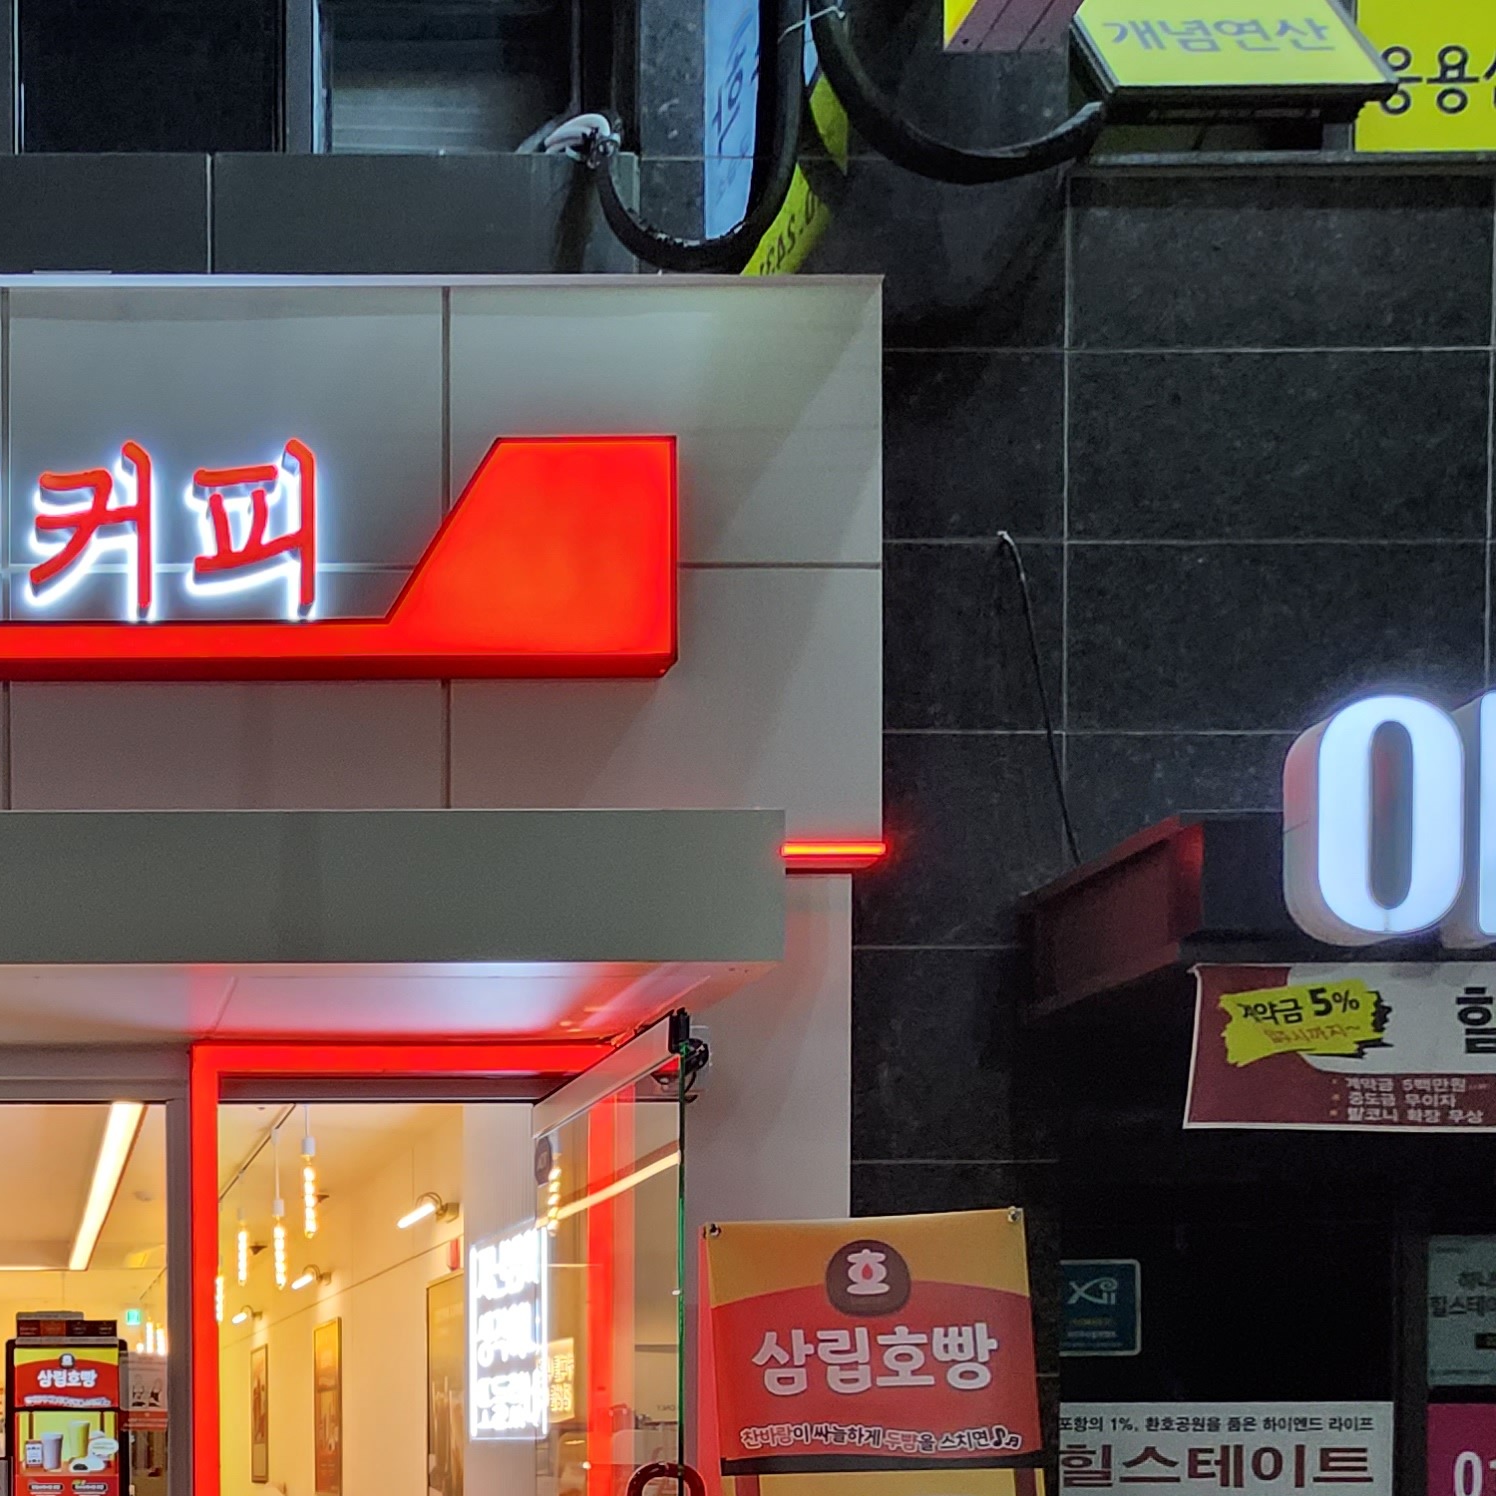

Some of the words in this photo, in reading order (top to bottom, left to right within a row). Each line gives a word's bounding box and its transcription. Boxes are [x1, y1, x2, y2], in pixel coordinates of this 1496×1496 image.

[1102, 16, 1335, 53] 개념연산
[1236, 999, 1303, 1026] 계약금
[1308, 987, 1360, 1017] 5%
[1404, 1092, 1457, 1108] 무이자
[1347, 1107, 1398, 1122] 발코니
[1406, 1108, 1441, 1123] 확장
[1448, 1109, 1484, 1124] 무상
[751, 1321, 999, 1396] 삼립호빵
[37, 1369, 98, 1388] 삼립호빵
[740, 1423, 811, 1449] 찬바람이
[812, 1423, 882, 1448] 싸늘하게
[938, 1427, 990, 1451] 스치면
[1059, 1416, 1104, 1432] 포항의
[1145, 1416, 1221, 1432] 환호공원을
[1226, 1416, 1256, 1432] 품은
[1262, 1416, 1324, 1432] 하이엔드
[1328, 1416, 1375, 1432] 라이프
[1059, 1443, 1374, 1488] 힐스테이트
